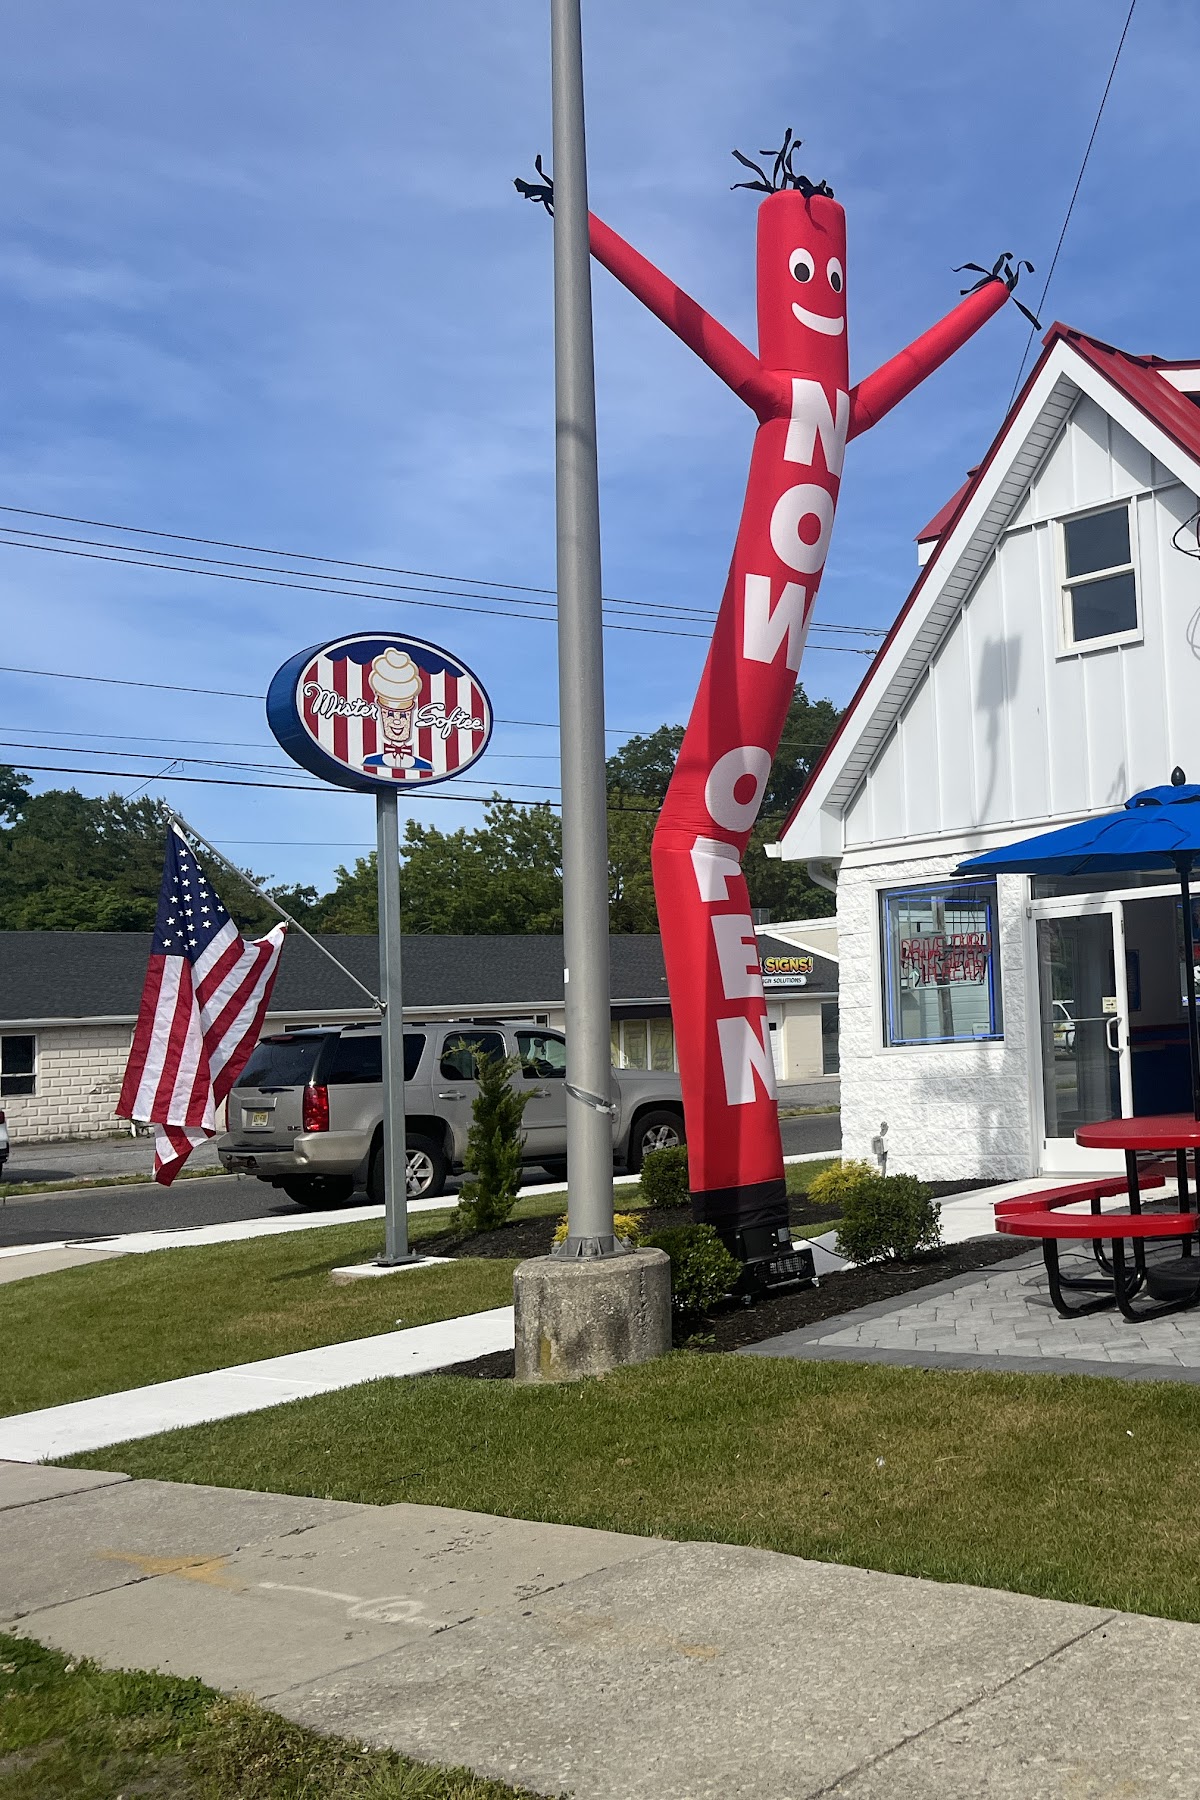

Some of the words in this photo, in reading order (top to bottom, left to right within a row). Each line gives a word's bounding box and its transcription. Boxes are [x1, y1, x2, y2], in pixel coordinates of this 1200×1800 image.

[743, 377, 850, 673] NOW
[303, 681, 380, 721] Mister
[415, 702, 485, 740] Softee
[689, 745, 777, 1106] OPEN
[764, 956, 813, 974] SIGNS!
